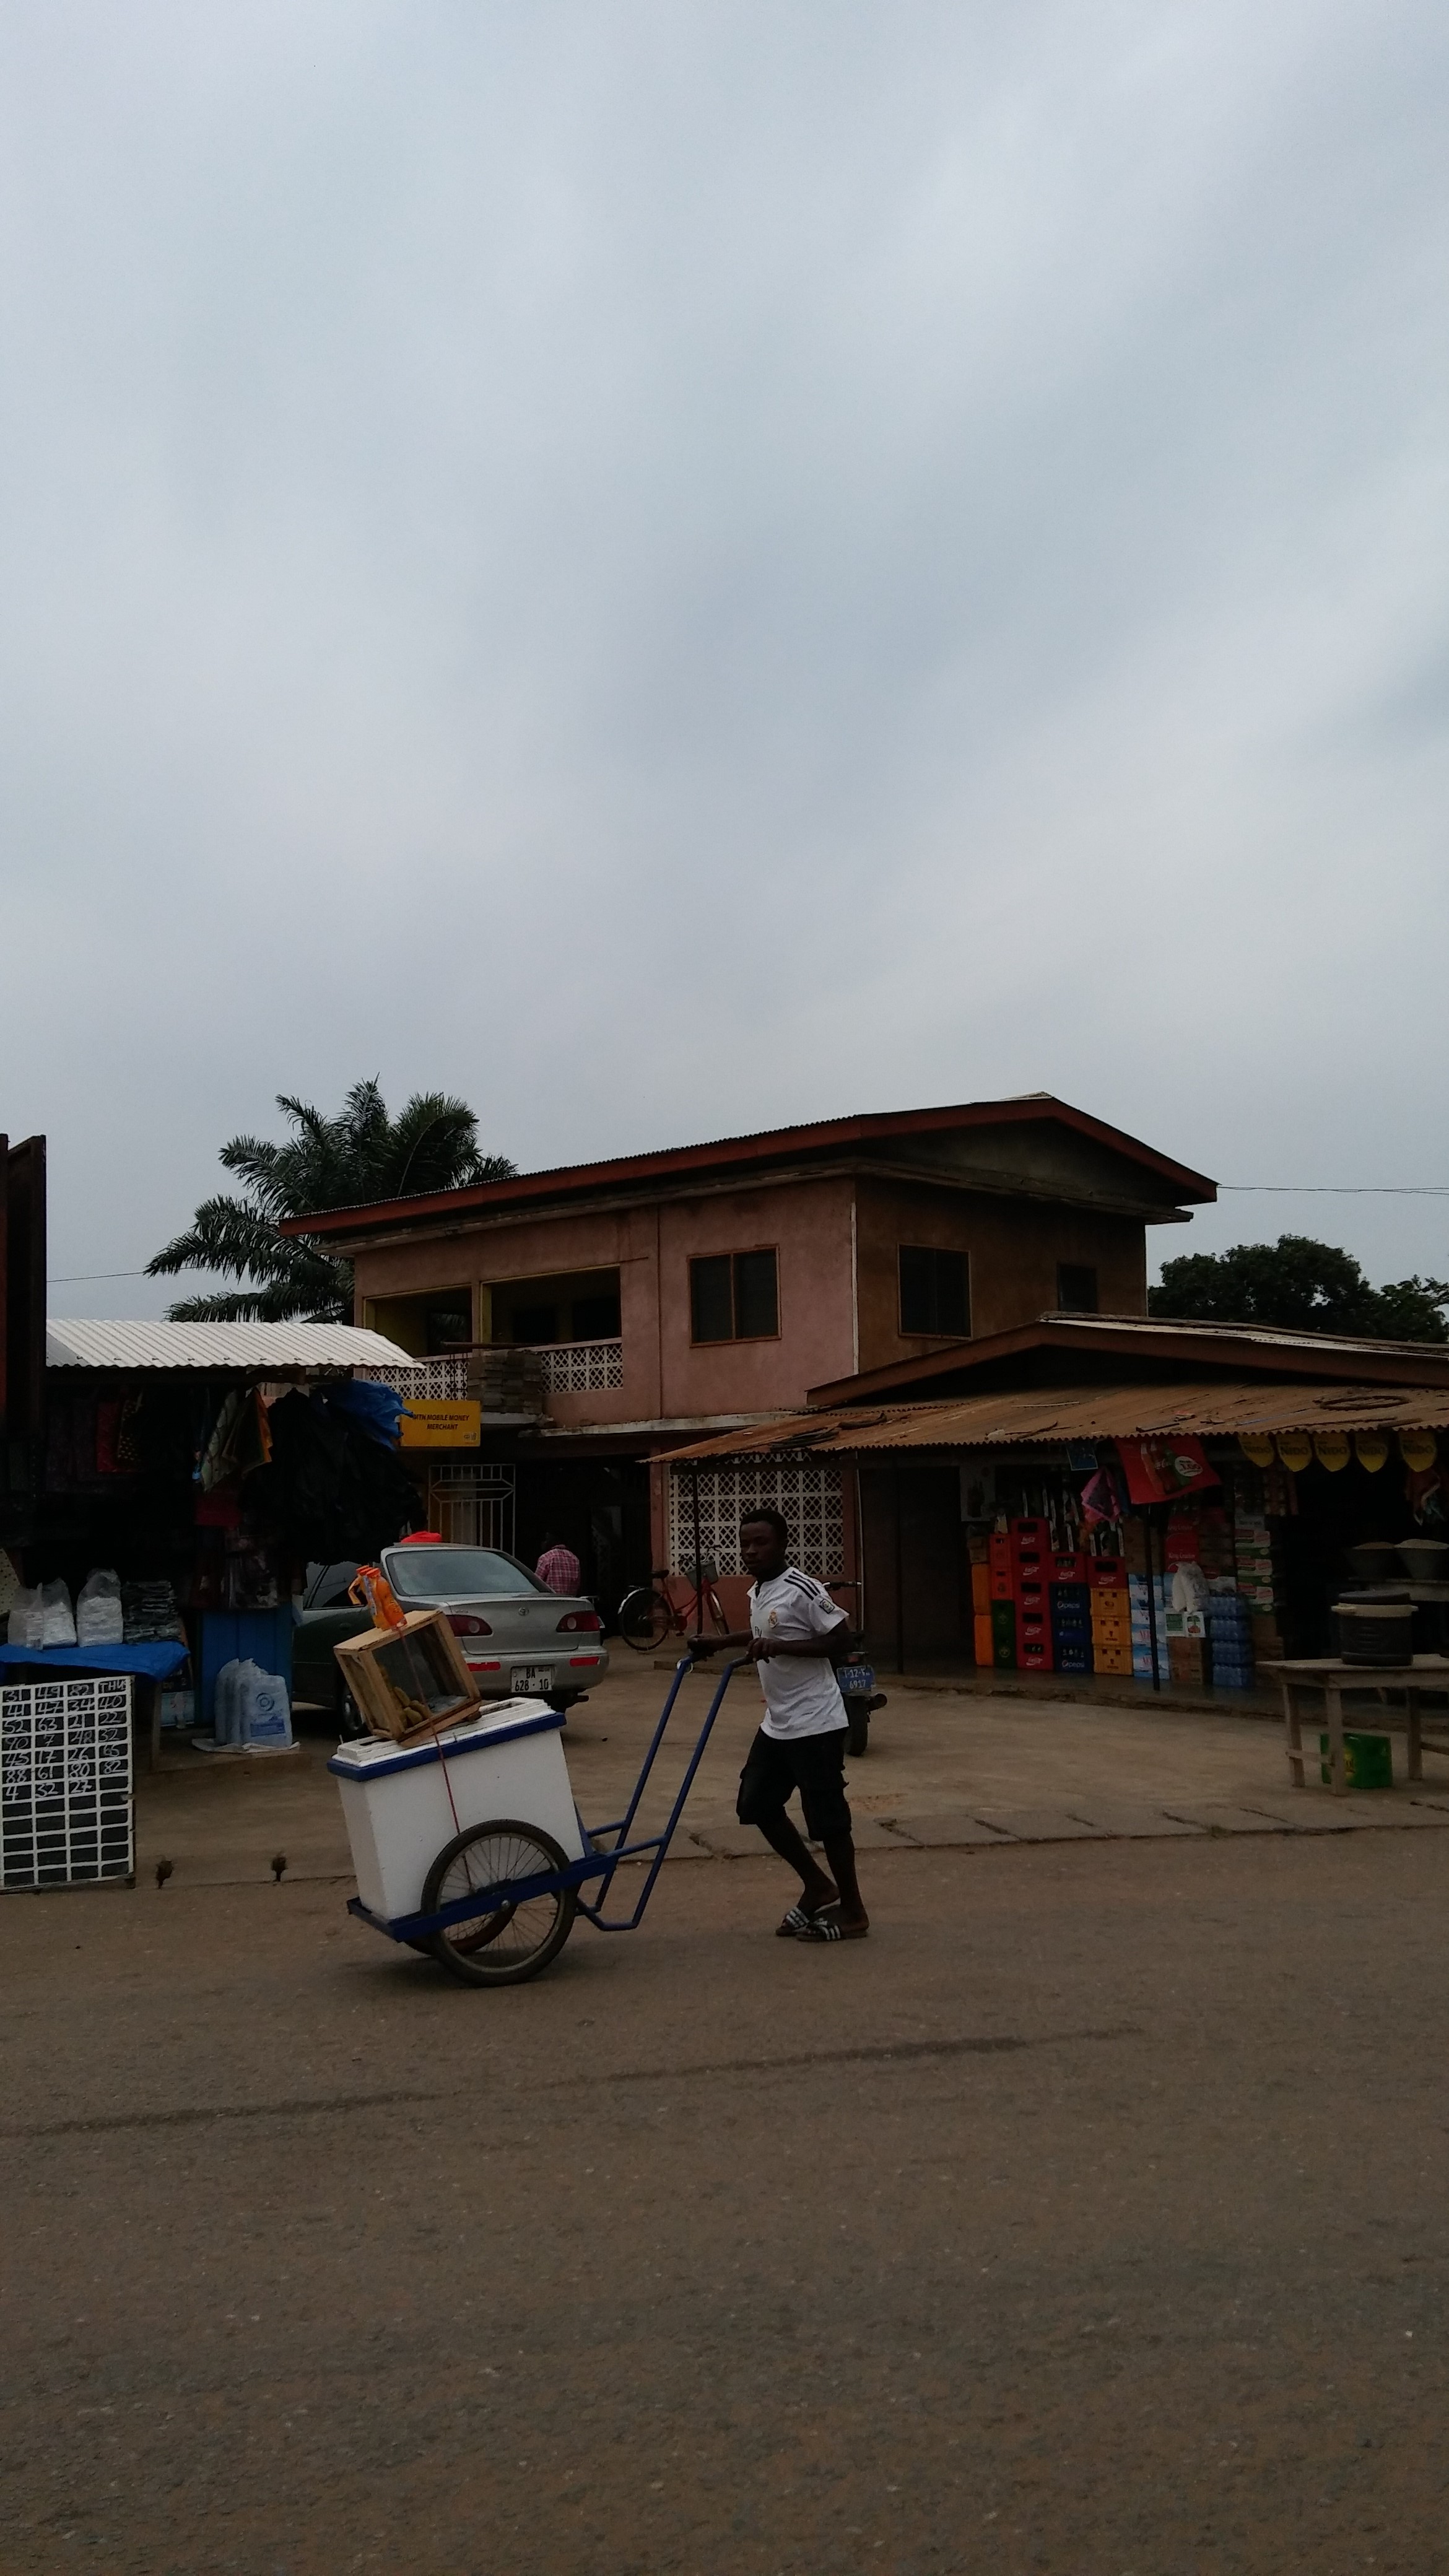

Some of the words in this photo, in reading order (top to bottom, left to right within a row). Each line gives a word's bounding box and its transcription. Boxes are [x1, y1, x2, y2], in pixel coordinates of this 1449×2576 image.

[526, 1668, 536, 1679] BA
[515, 1679, 529, 1691] 628
[539, 1678, 549, 1690] 10
[849, 1679, 866, 1689] 6917
[5, 1689, 22, 1702] 31
[37, 1686, 61, 1699] 49
[37, 1700, 64, 1715] 47
[68, 1698, 95, 1712] 34
[99, 1695, 123, 1709] 40
[2, 1719, 27, 1734] 52
[38, 1717, 58, 1731] 63
[69, 1713, 85, 1728] 21
[100, 1712, 122, 1725] 22
[43, 1734, 56, 1747] 7
[70, 1730, 93, 1744] 48
[98, 1728, 121, 1743] 32
[5, 1752, 30, 1767] 45
[38, 1749, 57, 1764] 17
[68, 1747, 89, 1761] 26
[6, 1769, 27, 1783] 88
[37, 1766, 54, 1779] 61
[69, 1763, 90, 1778] 80
[103, 1760, 128, 1774] 82
[6, 1785, 20, 1801] 4
[35, 1782, 59, 1797] 32
[69, 1778, 93, 1794] 27
